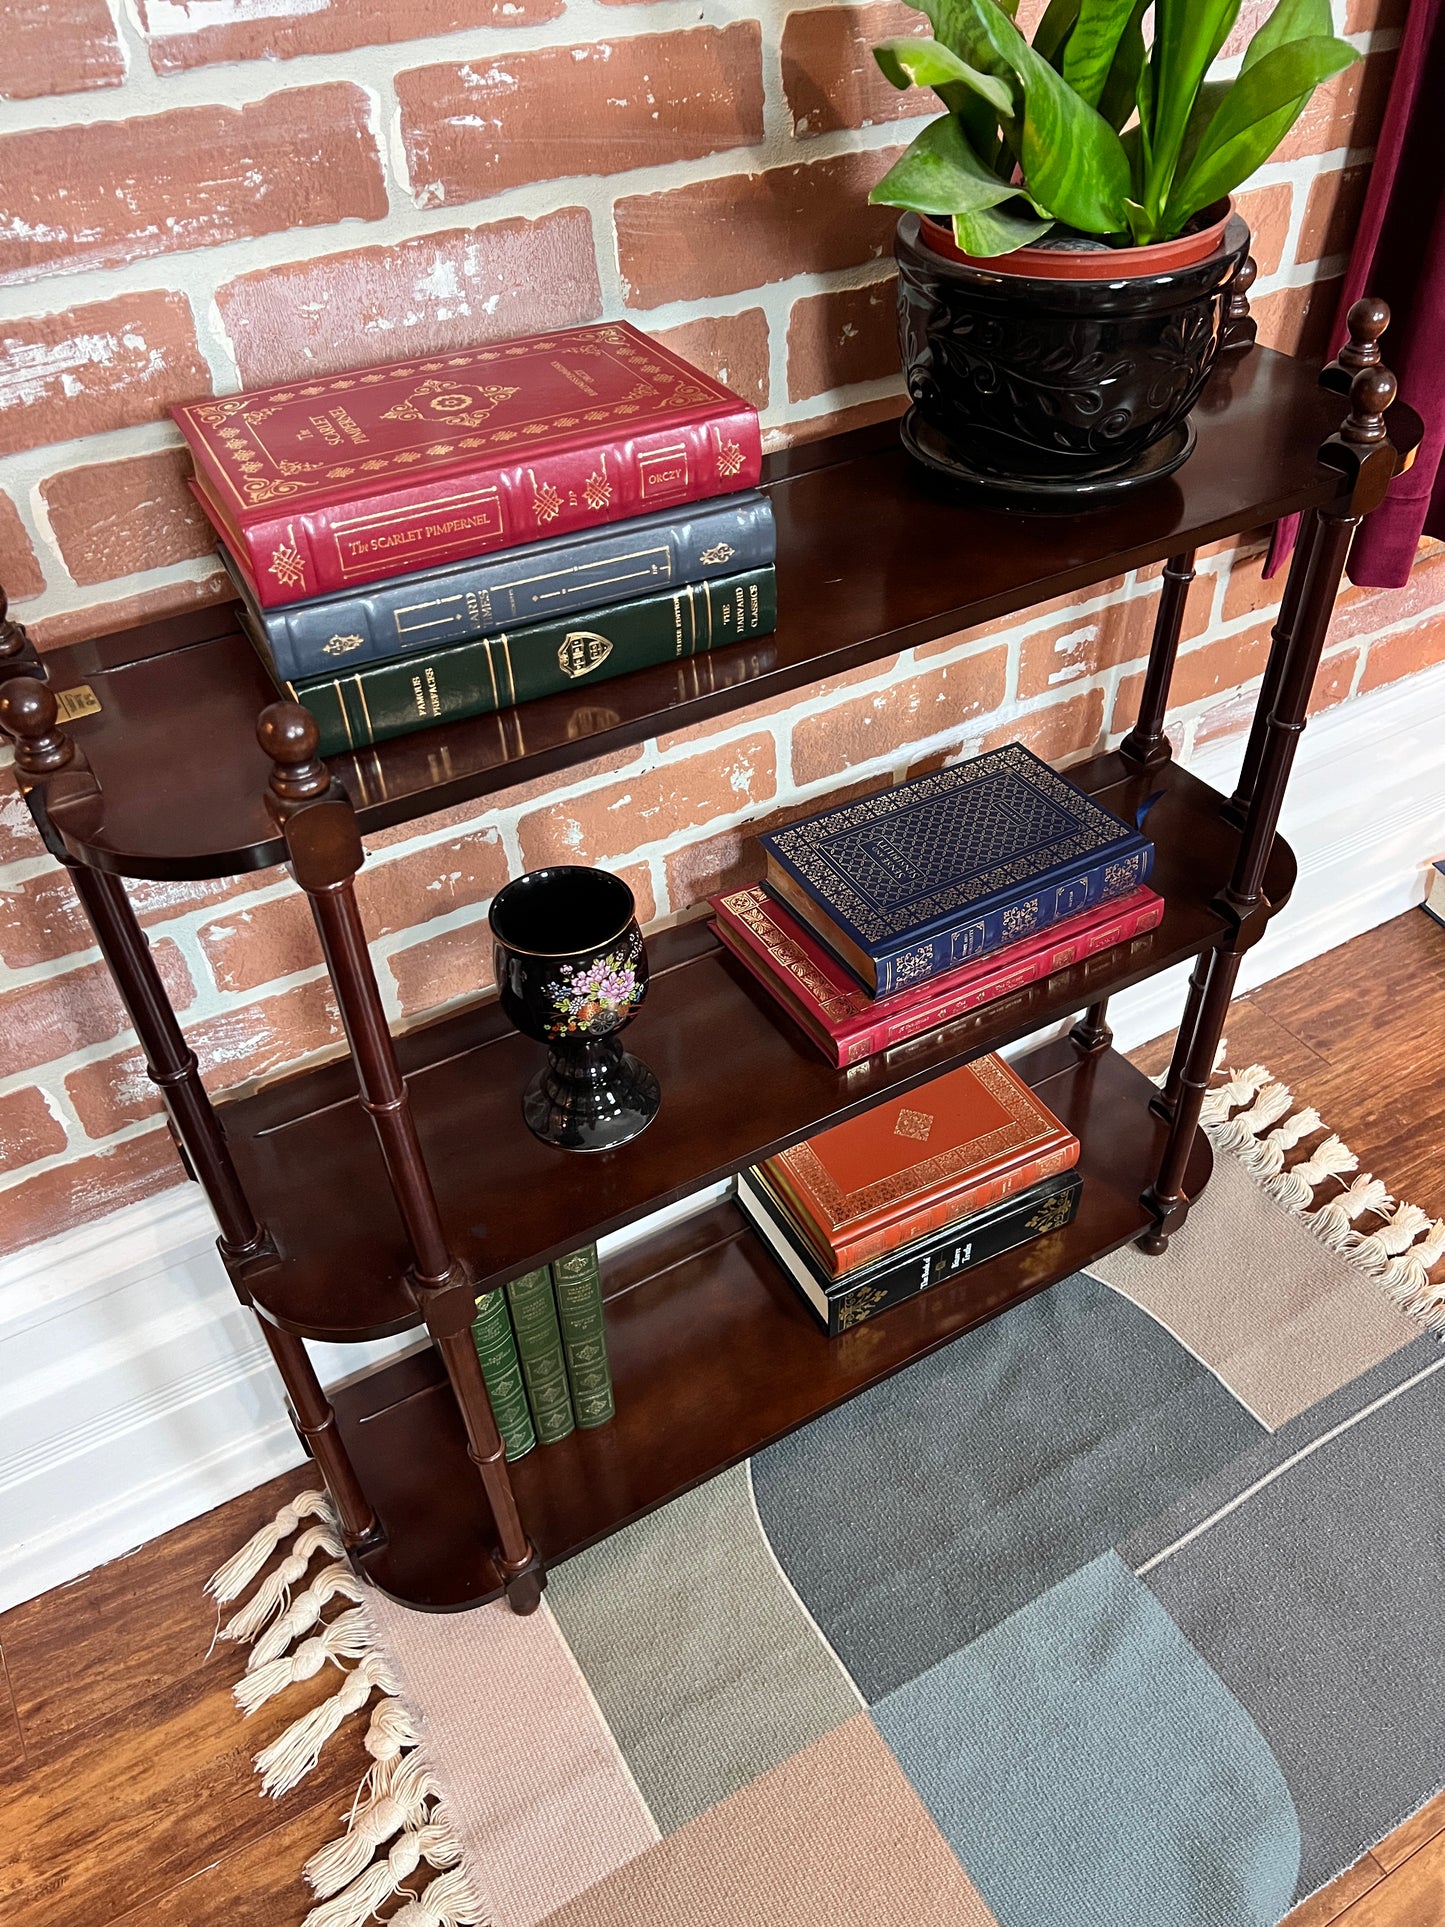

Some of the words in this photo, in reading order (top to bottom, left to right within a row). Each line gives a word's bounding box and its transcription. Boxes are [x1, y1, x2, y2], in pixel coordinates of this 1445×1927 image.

[309, 415, 345, 446] SCARLET
[328, 405, 370, 445] PIMPERNEL
[648, 469, 682, 485] ORCZY
[348, 539, 369, 556] The
[370, 528, 423, 551] SCARLET
[426, 513, 491, 538] PIMPERNEL
[722, 603, 731, 626] THE
[735, 586, 744, 633] HARVARD
[749, 584, 759, 628] CLASSICS
[412, 675, 427, 717] FAMOUS
[424, 667, 442, 717] PREFACES
